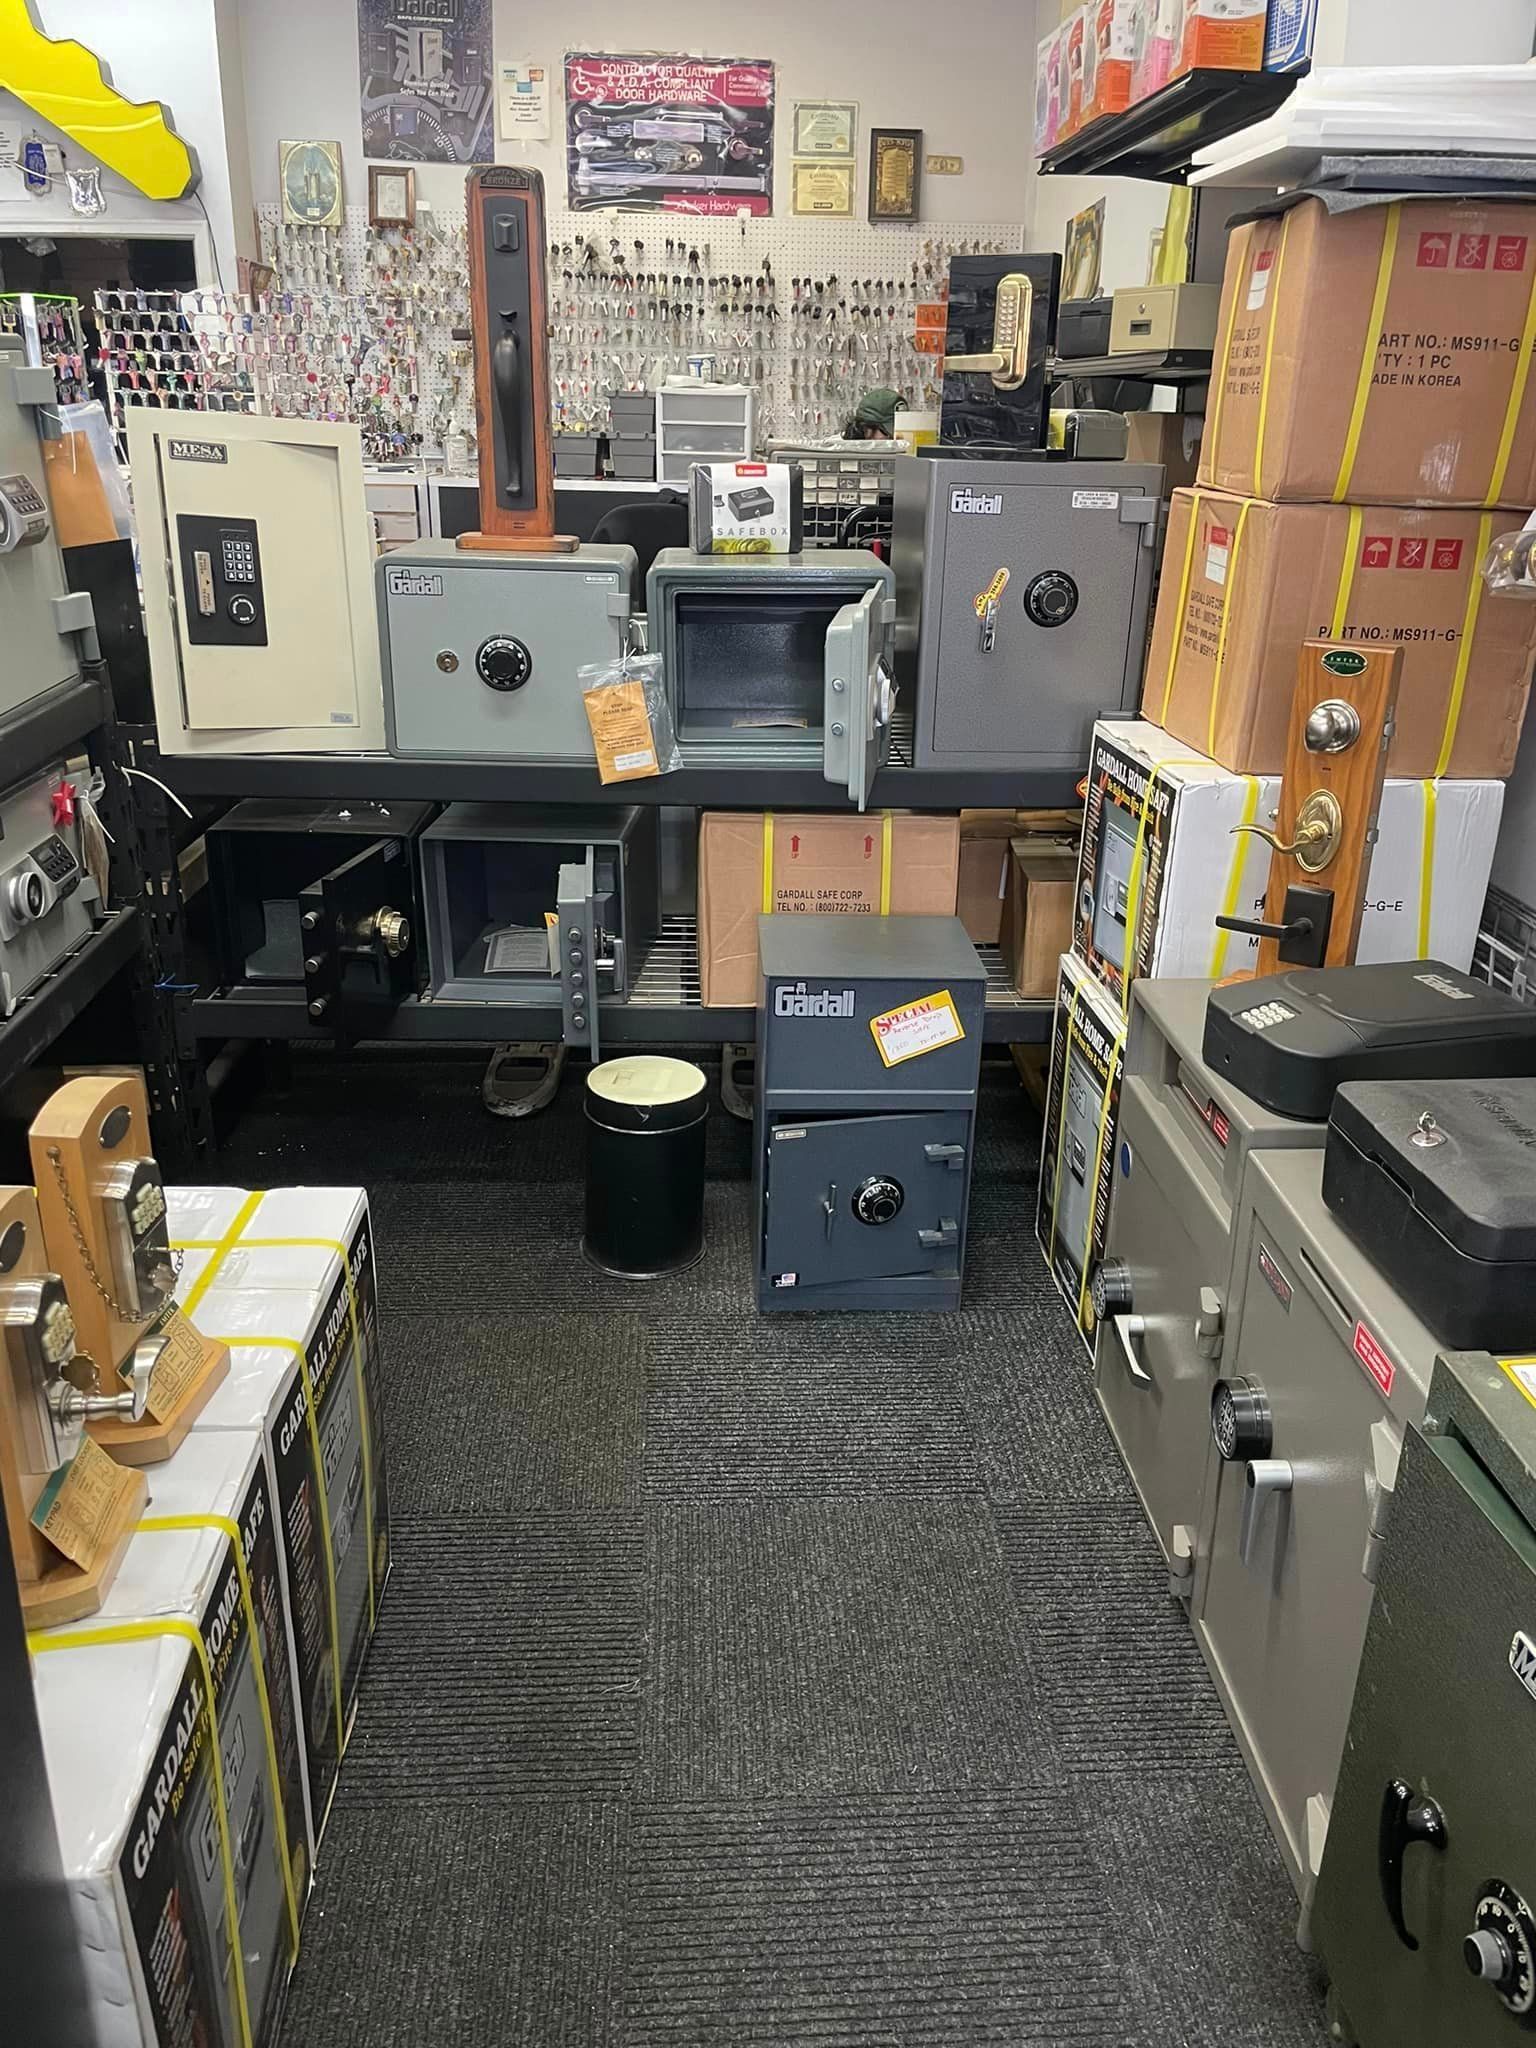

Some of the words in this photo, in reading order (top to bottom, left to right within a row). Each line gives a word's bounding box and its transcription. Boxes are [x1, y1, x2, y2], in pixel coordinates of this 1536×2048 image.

[600, 63, 673, 77] CONTRACTOR
[607, 77, 615, 87] &
[654, 77, 715, 90] COMPLIANT
[615, 88, 646, 100] DOOR
[649, 89, 707, 102] HARDWARE
[1378, 333, 1410, 348] ART
[1430, 354, 1451, 369] PC
[1372, 373, 1398, 385] ADE
[1401, 374, 1414, 386] IN
[1418, 375, 1461, 387] KOREA
[173, 442, 223, 459] MESA
[1096, 747, 1127, 785] GARDALL
[777, 890, 815, 899] GARDALL
[816, 890, 838, 900] SAFE
[840, 891, 863, 900] CORP
[777, 902, 791, 911] TEL
[1083, 1017, 1105, 1055] HOME
[133, 1678, 204, 1880] GARDALL
[243, 1487, 265, 1566] AFE
